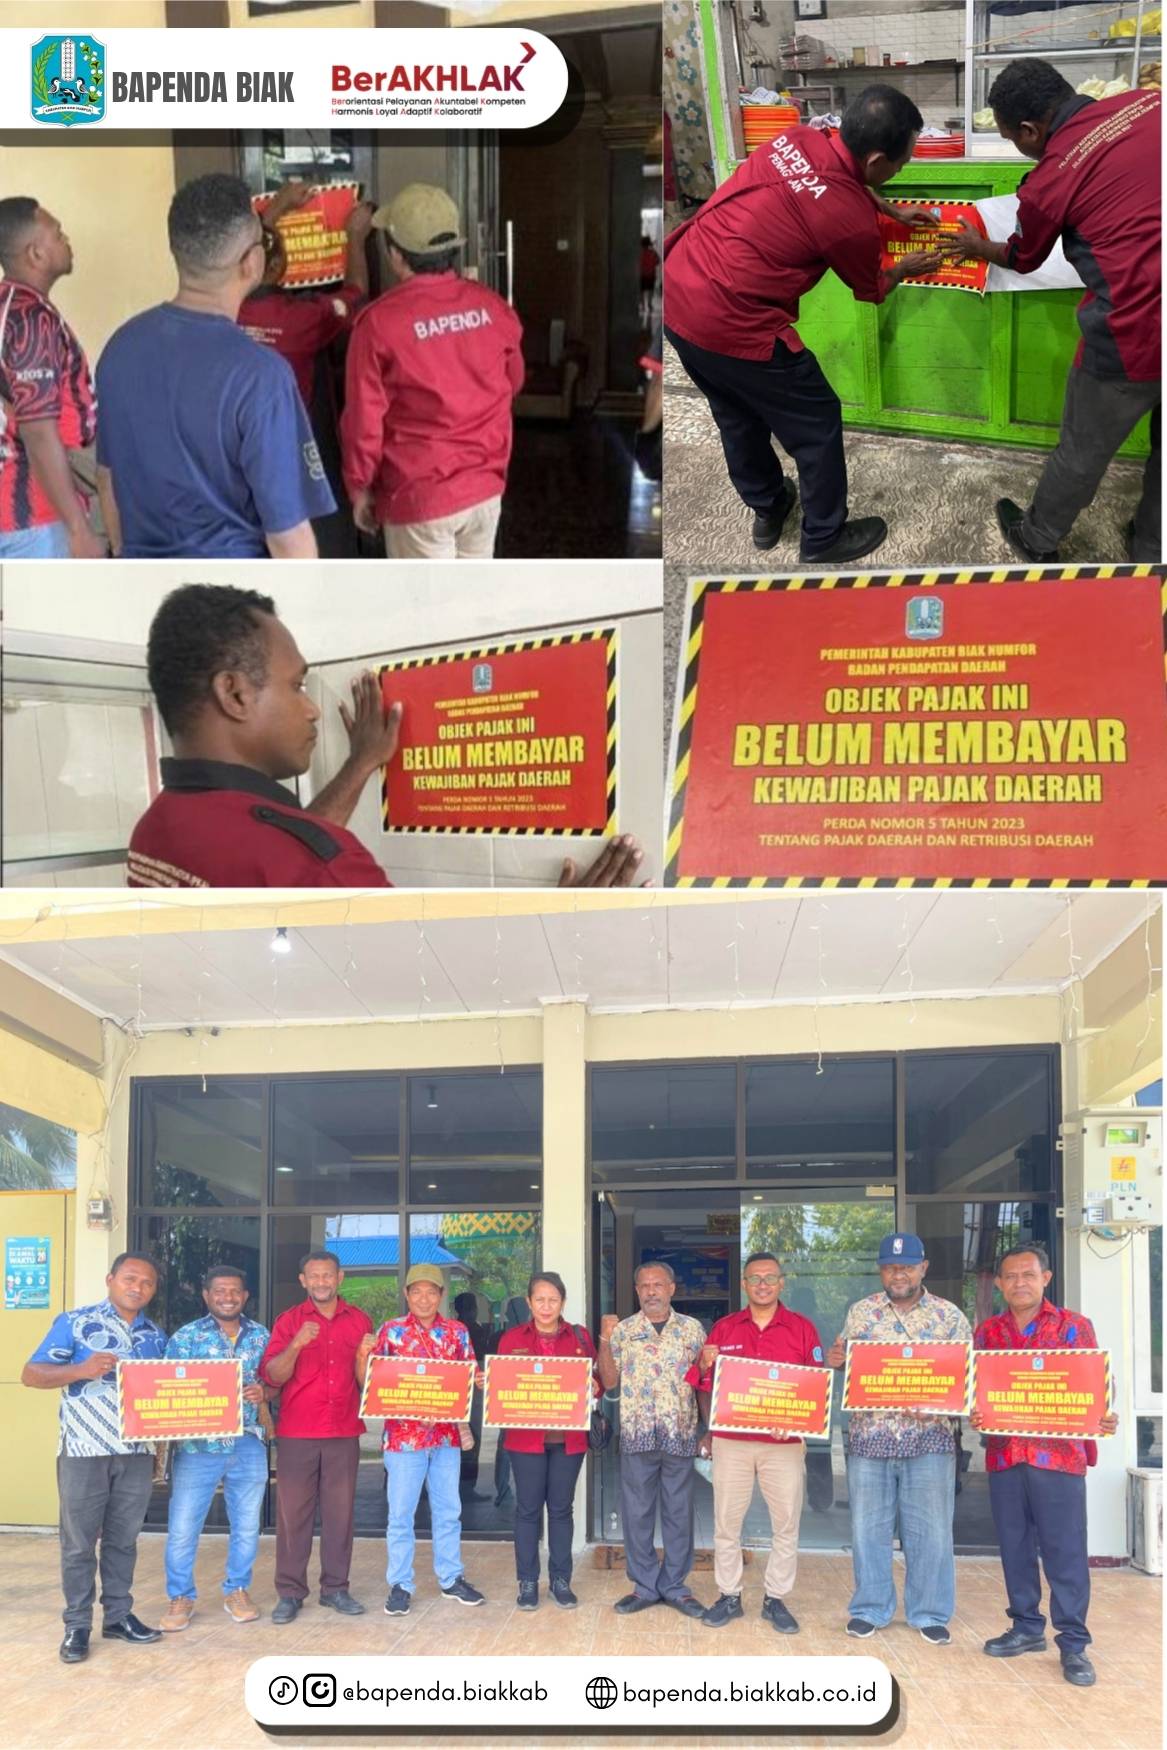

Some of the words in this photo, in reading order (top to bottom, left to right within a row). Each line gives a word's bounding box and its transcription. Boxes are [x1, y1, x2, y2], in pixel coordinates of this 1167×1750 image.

[772, 135, 828, 199] BAPENDA
[887, 241, 923, 254] BELUM
[413, 309, 492, 339] BAPENDA
[820, 648, 889, 660] PEMERINTAH
[891, 646, 955, 659] KABUPATEN
[958, 645, 986, 657] BIAK
[988, 643, 1037, 656] NUMFOR
[848, 663, 885, 676] BADAN
[888, 661, 958, 675] PENDAPATAN
[961, 660, 1006, 673] DAERAH
[824, 686, 902, 714] OBJEK
[907, 685, 987, 712] PAJAK
[991, 683, 1029, 710] INI
[438, 722, 473, 740] OBJEK
[476, 719, 513, 737] PAJAK
[516, 717, 535, 734] INI
[732, 722, 872, 767] BELUM
[882, 718, 1128, 765] MEMBAYAR
[402, 743, 461, 771] BELUM
[466, 735, 585, 767] MEMBAYAR
[413, 773, 476, 790] KEWAJIBAN
[478, 771, 516, 788] PAJAK
[518, 769, 571, 787] DAERAH
[753, 776, 902, 804] KEWAJIBAN
[907, 775, 990, 803] PAJAK
[994, 773, 1102, 803] DAERAH
[823, 818, 866, 829] PERDA
[870, 818, 925, 829] NOMOR
[928, 818, 936, 829] 5
[940, 818, 988, 829] TAHUN
[992, 818, 1025, 829] 2023
[759, 835, 820, 846] TENTANG
[824, 835, 863, 846] PAJAK
[867, 835, 922, 846] DAERAH
[927, 835, 956, 846] DAN
[961, 835, 1031, 846] RETRIBUSI
[1035, 835, 1094, 847] DAERAH
[1110, 1182, 1137, 1192] PLN
[860, 1375, 894, 1385] BELUM
[896, 1375, 956, 1386] MEMBAYAR
[728, 1391, 760, 1406] BELUM
[762, 1396, 817, 1411] MEMBAYAR
[987, 1391, 1025, 1403] BELUM
[1028, 1391, 1094, 1405] MEMBAYAR
